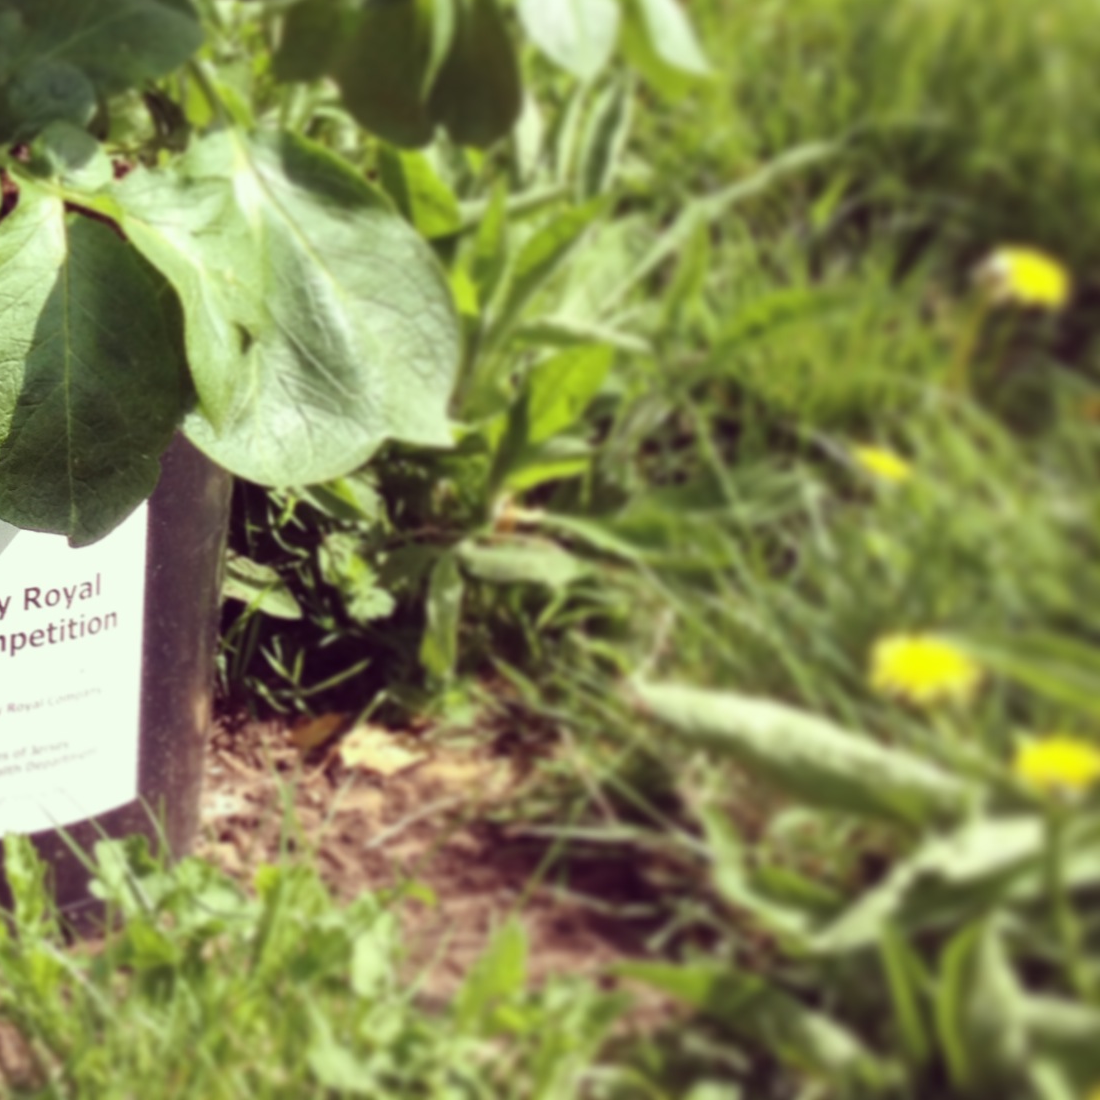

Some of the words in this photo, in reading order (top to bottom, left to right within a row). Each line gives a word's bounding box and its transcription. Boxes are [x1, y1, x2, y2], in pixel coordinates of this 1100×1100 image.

[23, 572, 101, 611] Royal
[7, 699, 44, 713] Royal
[12, 747, 27, 758] of
